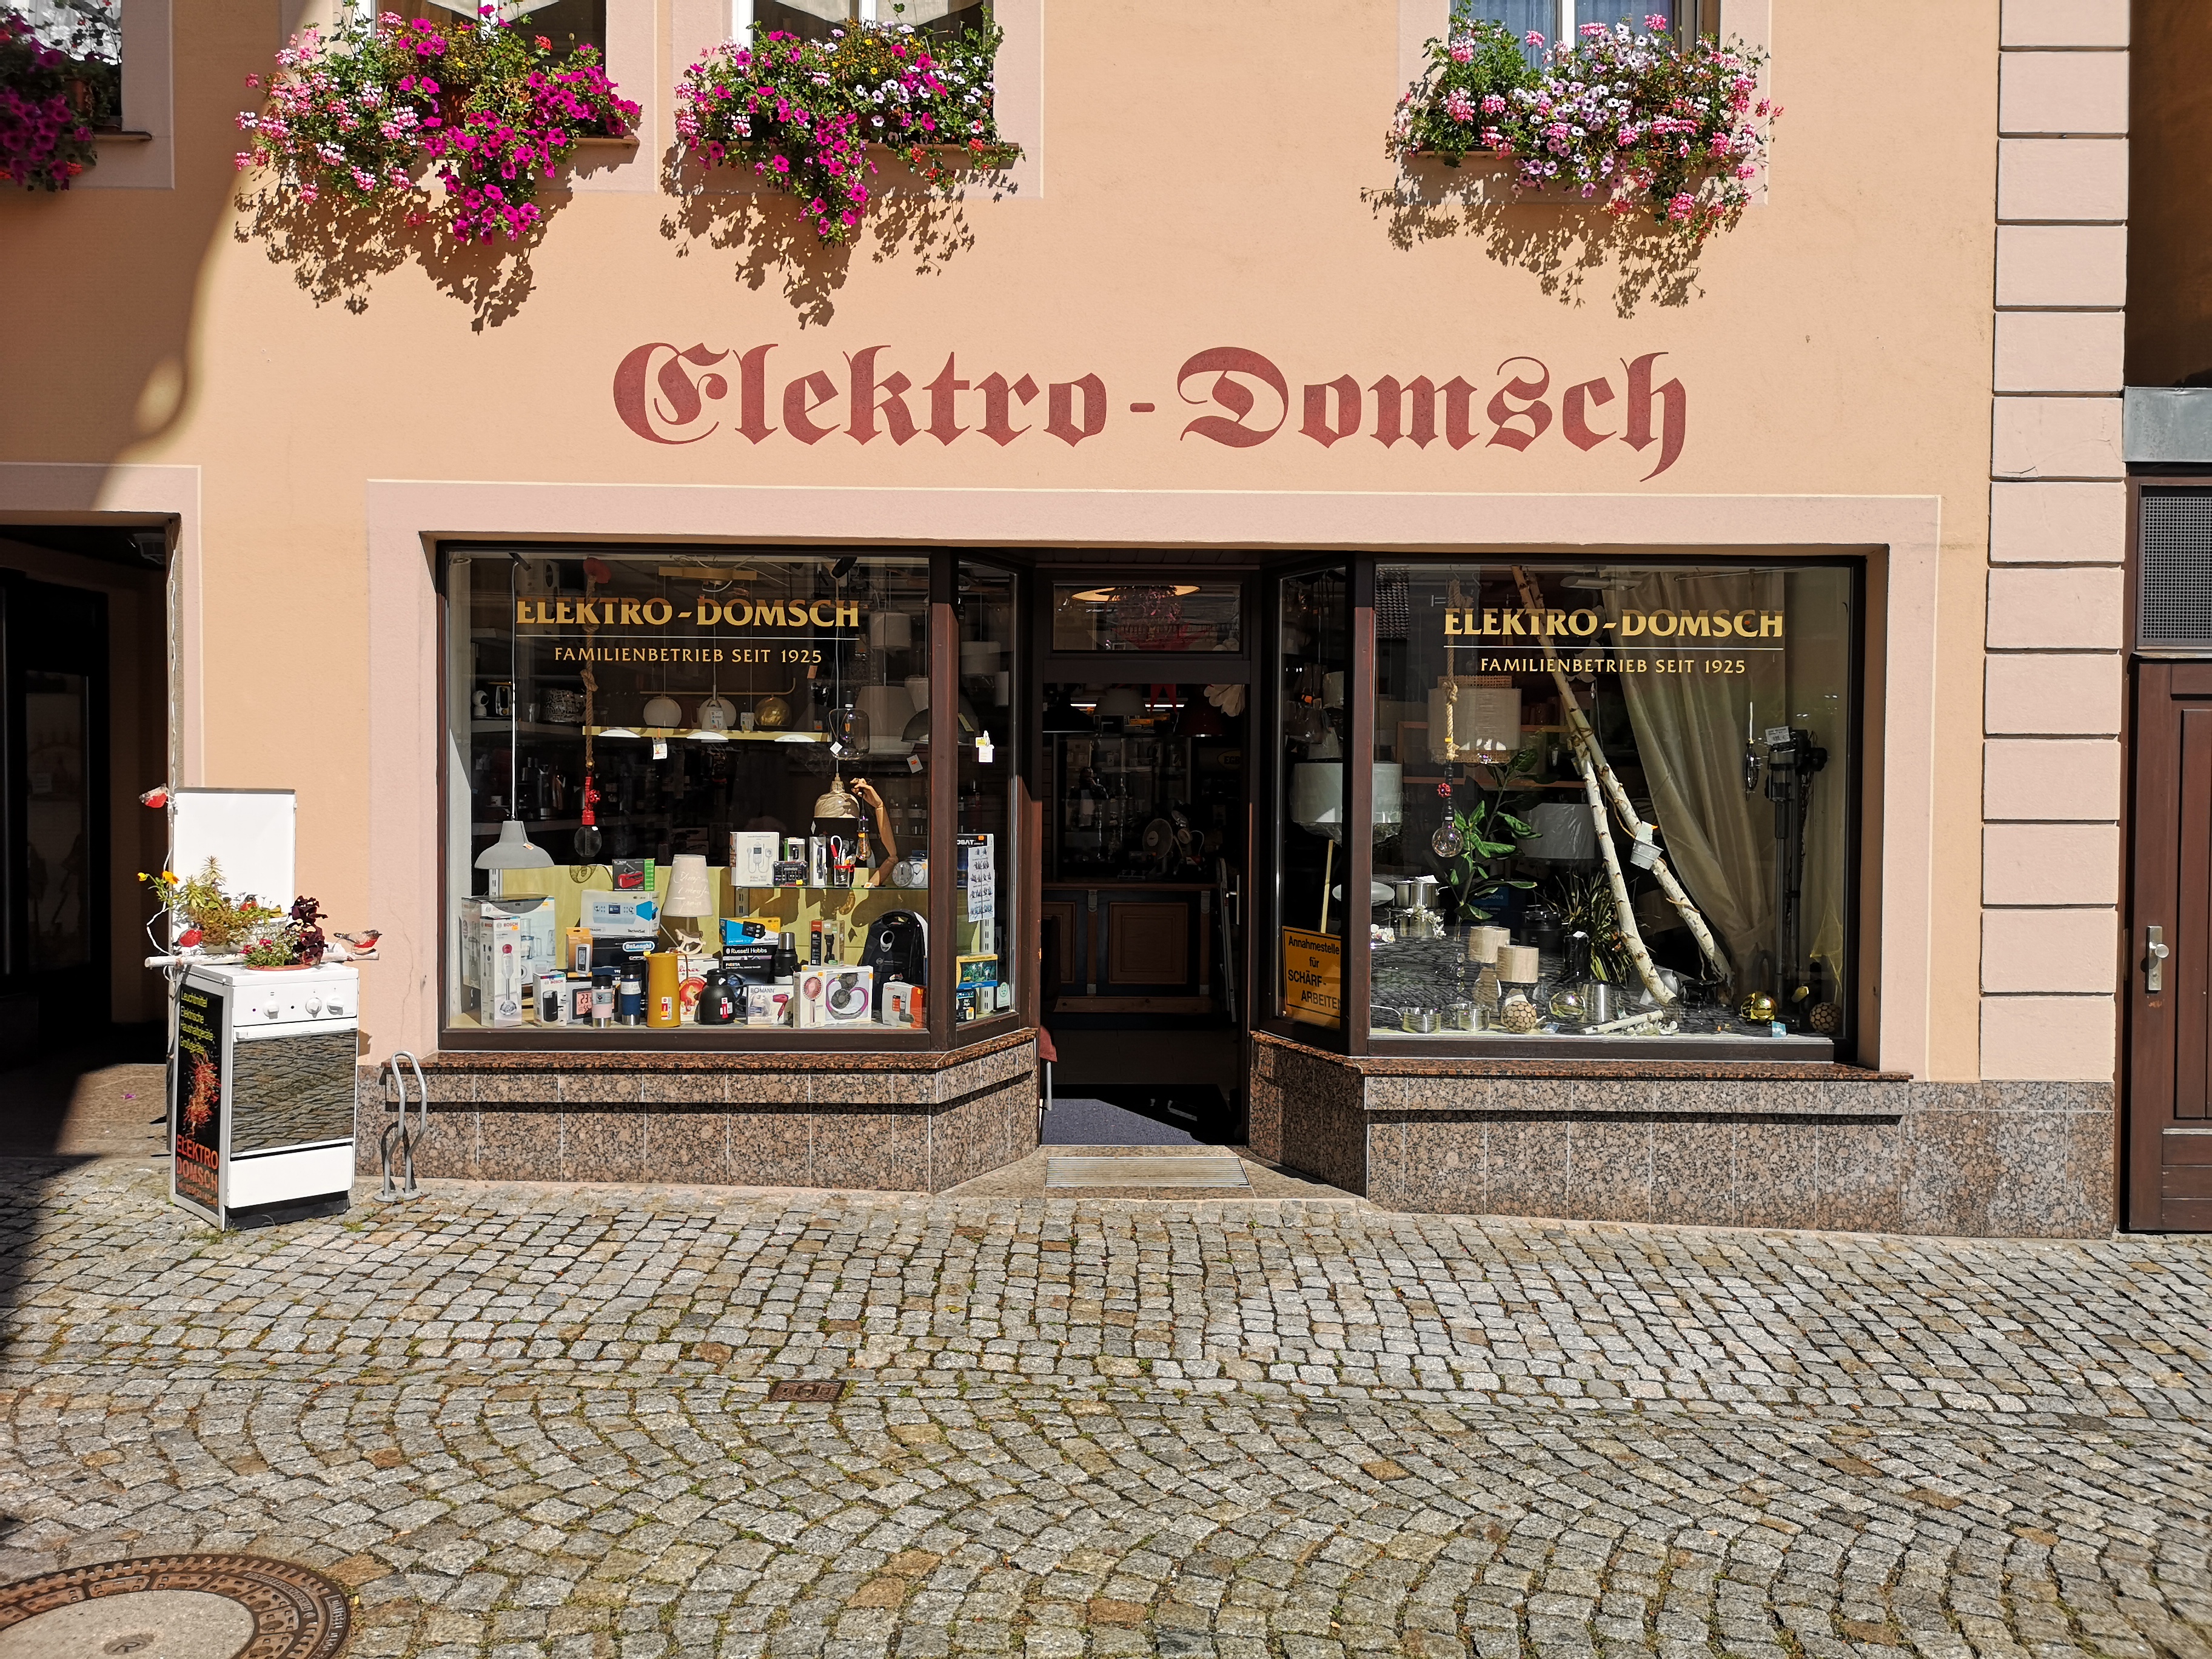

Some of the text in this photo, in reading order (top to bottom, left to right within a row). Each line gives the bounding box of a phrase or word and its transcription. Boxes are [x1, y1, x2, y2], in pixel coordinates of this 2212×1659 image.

[554, 647, 822, 663] FAMILIENBETRIEB SEIT 1925
[1481, 658, 1746, 674] FAMILIENBETRIEB SEIT 1925
[1288, 935, 1340, 955] Annahmestelle
[1309, 956, 1320, 968] für
[1288, 969, 1327, 988] SCHÄRF-
[176, 1133, 219, 1170] ELEKTRO
[176, 1156, 218, 1194] DOMSCH
